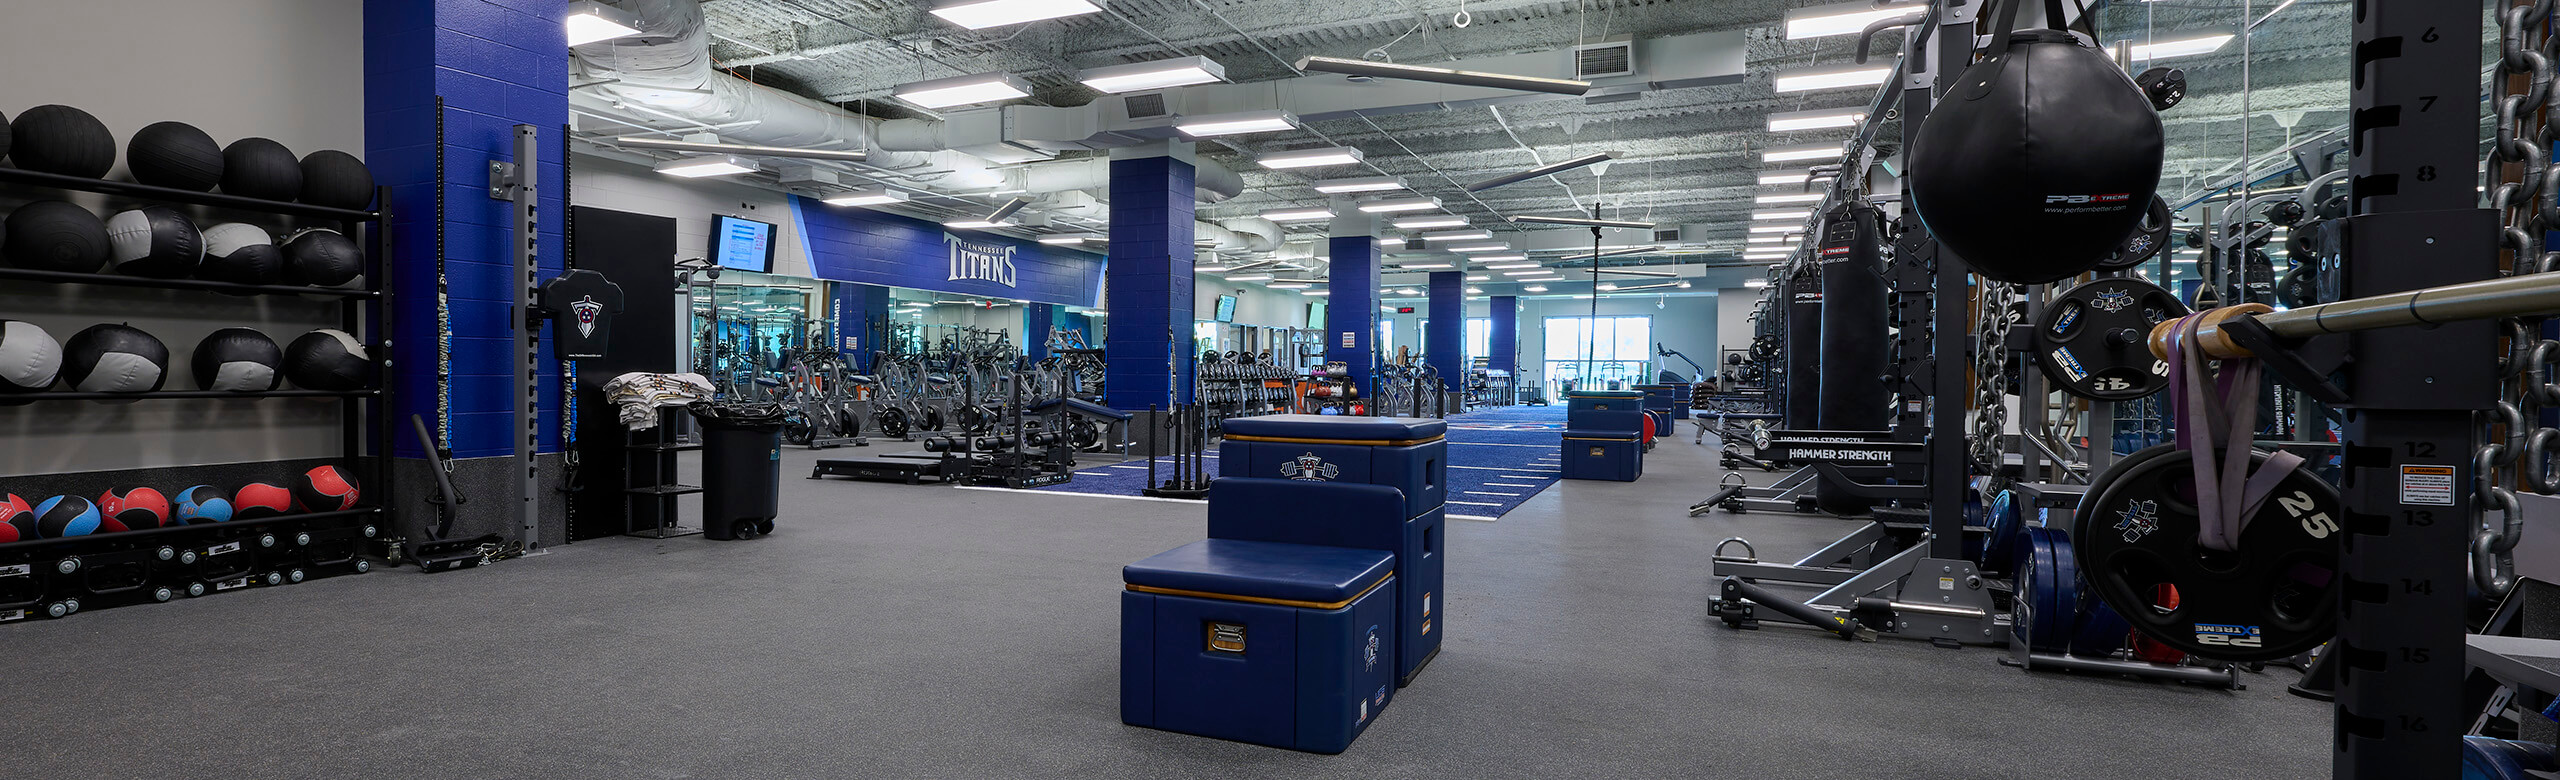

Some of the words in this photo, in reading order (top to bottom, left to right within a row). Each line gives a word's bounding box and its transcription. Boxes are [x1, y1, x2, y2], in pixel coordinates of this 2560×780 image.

[2421, 26, 2439, 43] 6
[2419, 95, 2438, 112] 7
[2416, 165, 2437, 182] 8
[2046, 194, 2090, 203] PB
[2044, 205, 2127, 214] www.performbetter.com
[963, 241, 1004, 254] TENNESSEE
[943, 230, 1017, 289] TITANS
[1789, 448, 1836, 459] HAMMER
[1837, 449, 1892, 461] STRENGTH
[2404, 441, 2437, 458] 12
[2277, 490, 2340, 539] 25
[2402, 509, 2434, 527] 13
[2196, 633, 2262, 648] PB
